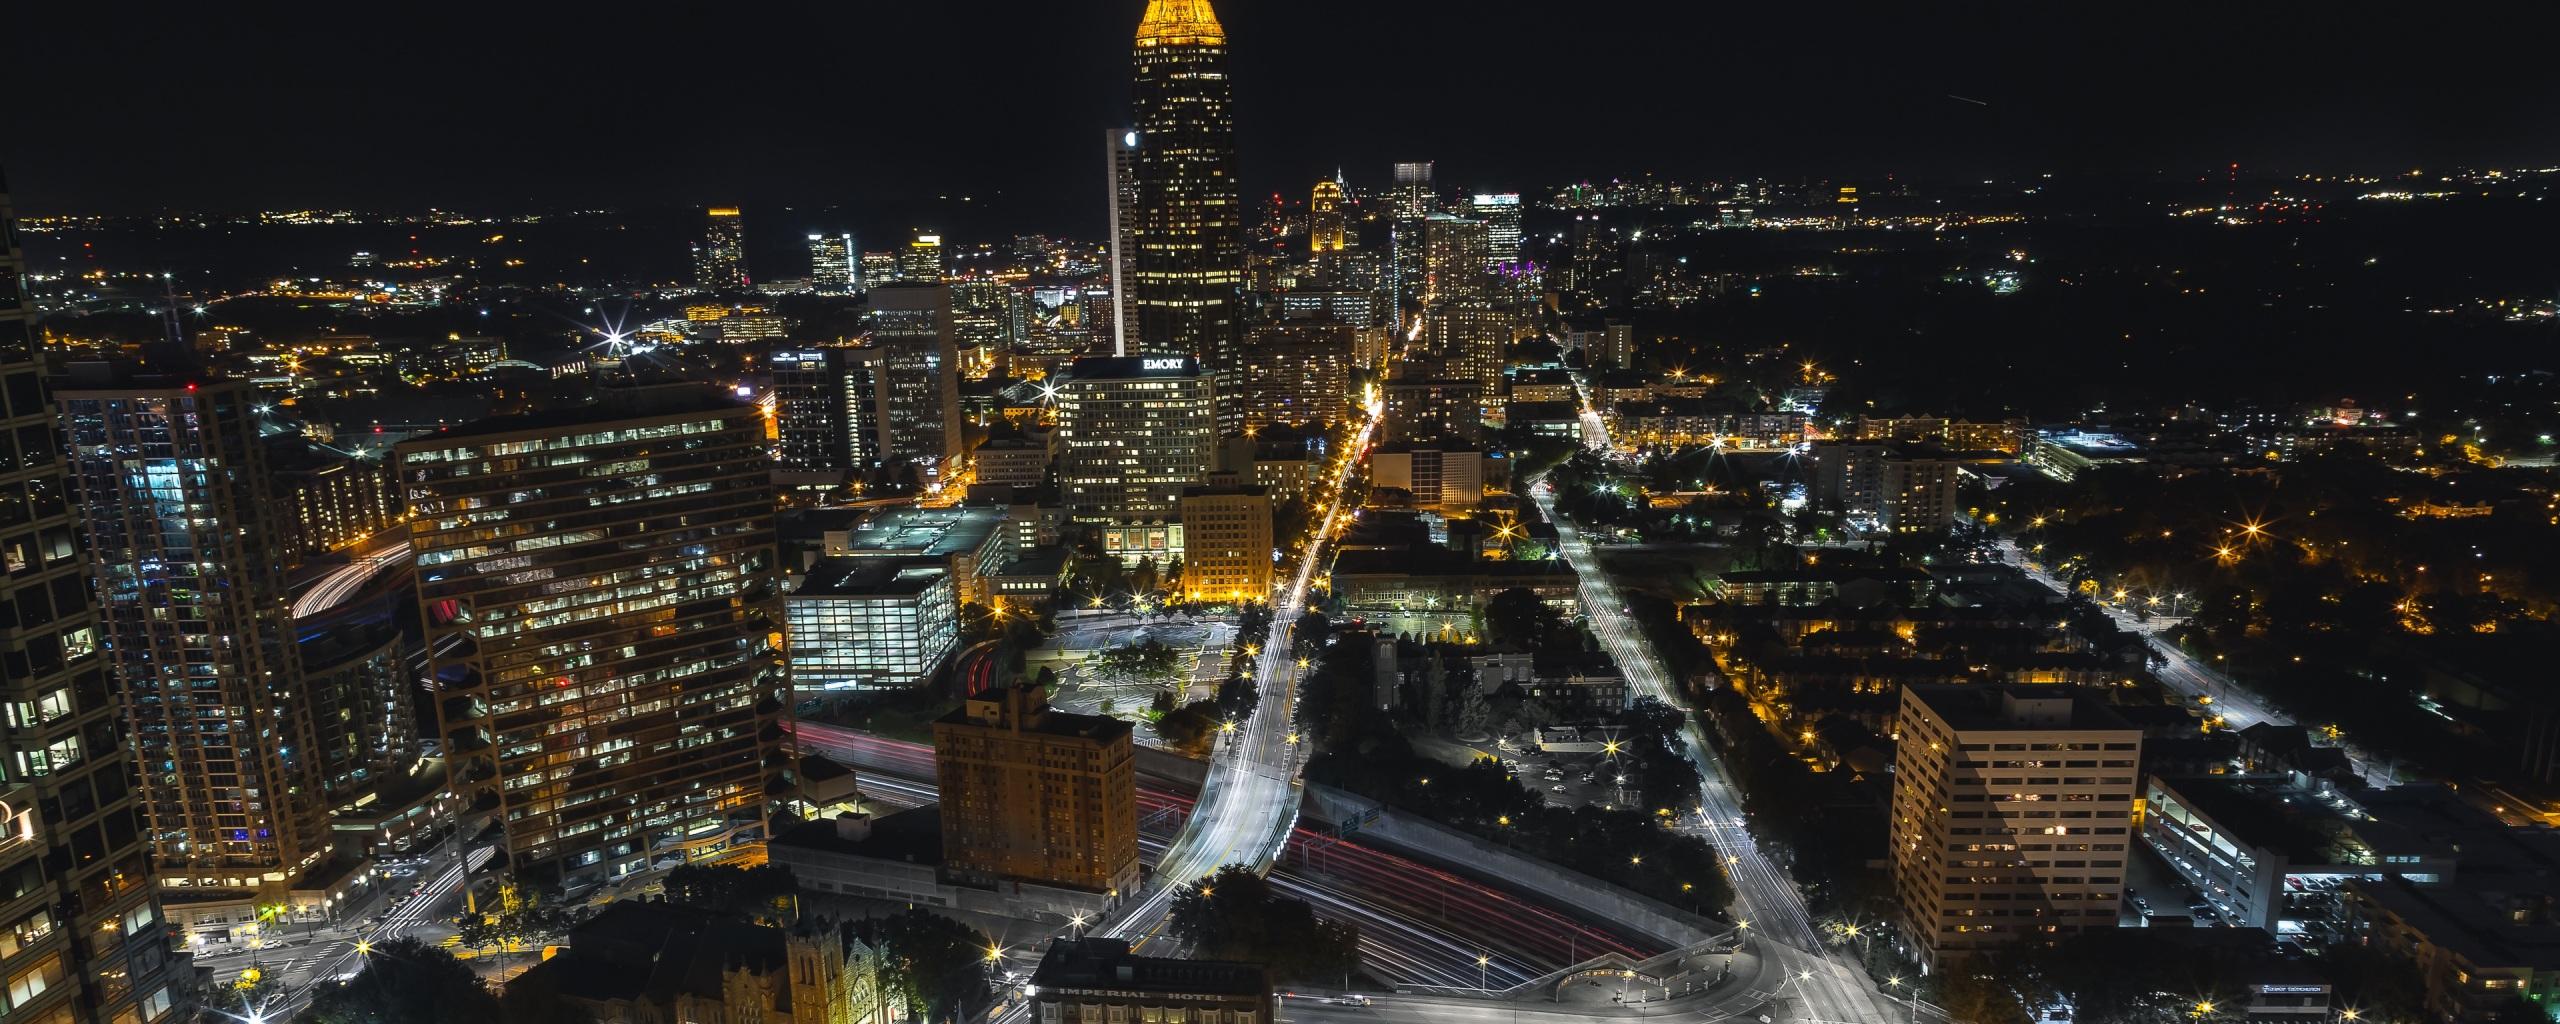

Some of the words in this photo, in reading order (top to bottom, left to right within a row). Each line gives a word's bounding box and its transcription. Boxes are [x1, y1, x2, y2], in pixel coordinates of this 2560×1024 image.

[1143, 359, 1184, 370] EMORY
[1059, 987, 1151, 999] IMPERIAL
[1167, 992, 1229, 1002] HOTEL
